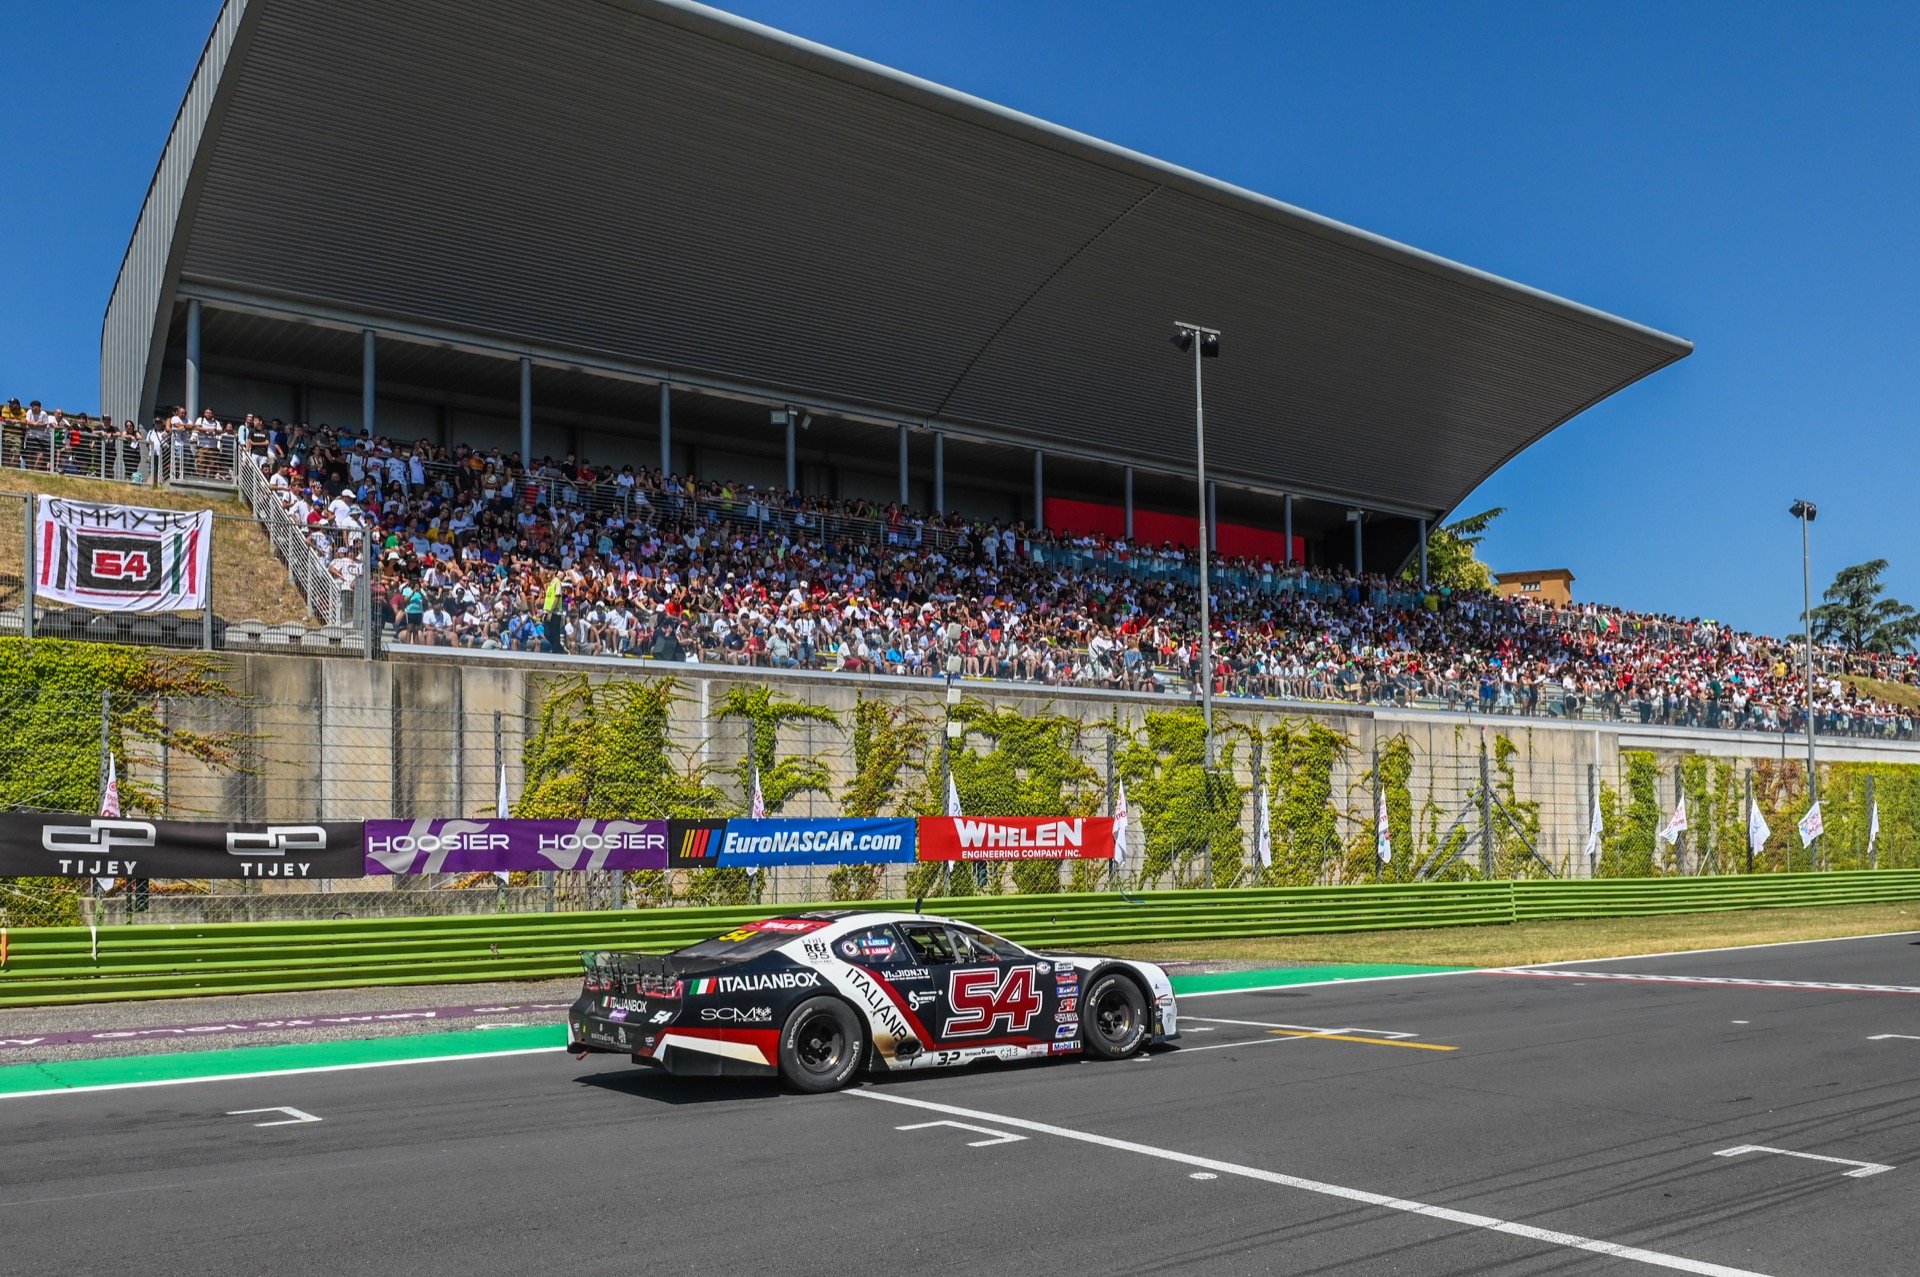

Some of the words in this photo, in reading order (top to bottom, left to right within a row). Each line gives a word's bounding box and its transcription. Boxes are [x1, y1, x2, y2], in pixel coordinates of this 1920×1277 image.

[49, 499, 148, 529] GIMMY
[93, 550, 149, 580] 54
[954, 817, 1083, 848] WHELEN
[368, 833, 510, 853] HOOSIER
[539, 833, 665, 850] HOOSIER
[723, 830, 902, 854] EuroNASCAR.com
[962, 849, 1020, 859] ENGINEERING
[1021, 848, 1060, 859] COMPANY
[1062, 848, 1082, 858] INC.
[59, 859, 138, 875] TIJEY
[240, 862, 311, 877] TIJEY
[718, 929, 759, 942] 54
[804, 943, 827, 953] RES
[808, 951, 830, 960] 95
[718, 971, 822, 993] ITALIANBOX
[609, 995, 647, 1014] ITALIANBOX
[942, 965, 1043, 1038] 54
[649, 1009, 673, 1024] 54
[701, 1007, 756, 1021] SCM
[1054, 1041, 1072, 1050] Mobil
